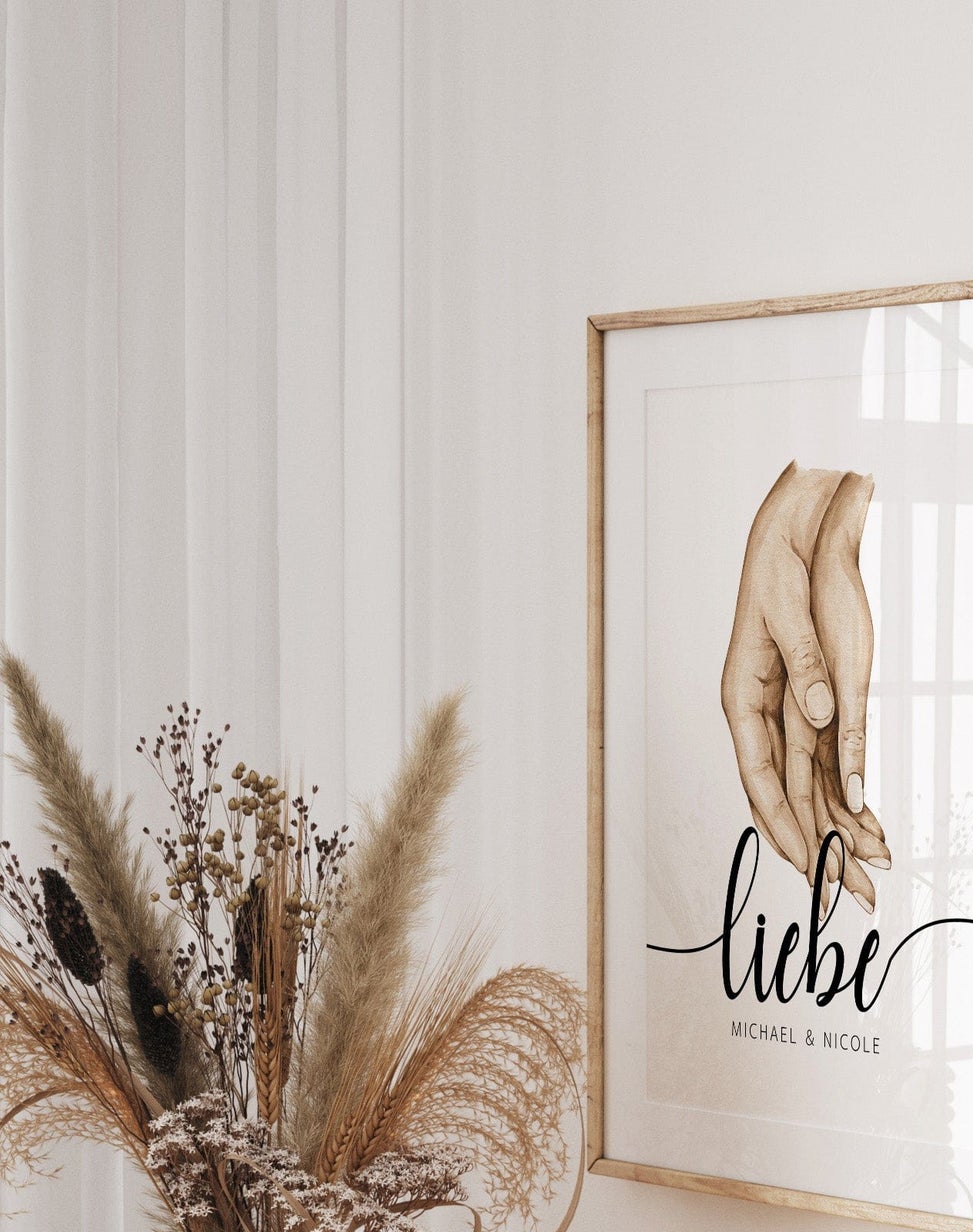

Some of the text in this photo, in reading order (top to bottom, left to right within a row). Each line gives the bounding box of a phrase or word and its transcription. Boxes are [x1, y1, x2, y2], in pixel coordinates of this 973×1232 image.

[731, 1020, 880, 1055] MICHAEL & NICOLE
